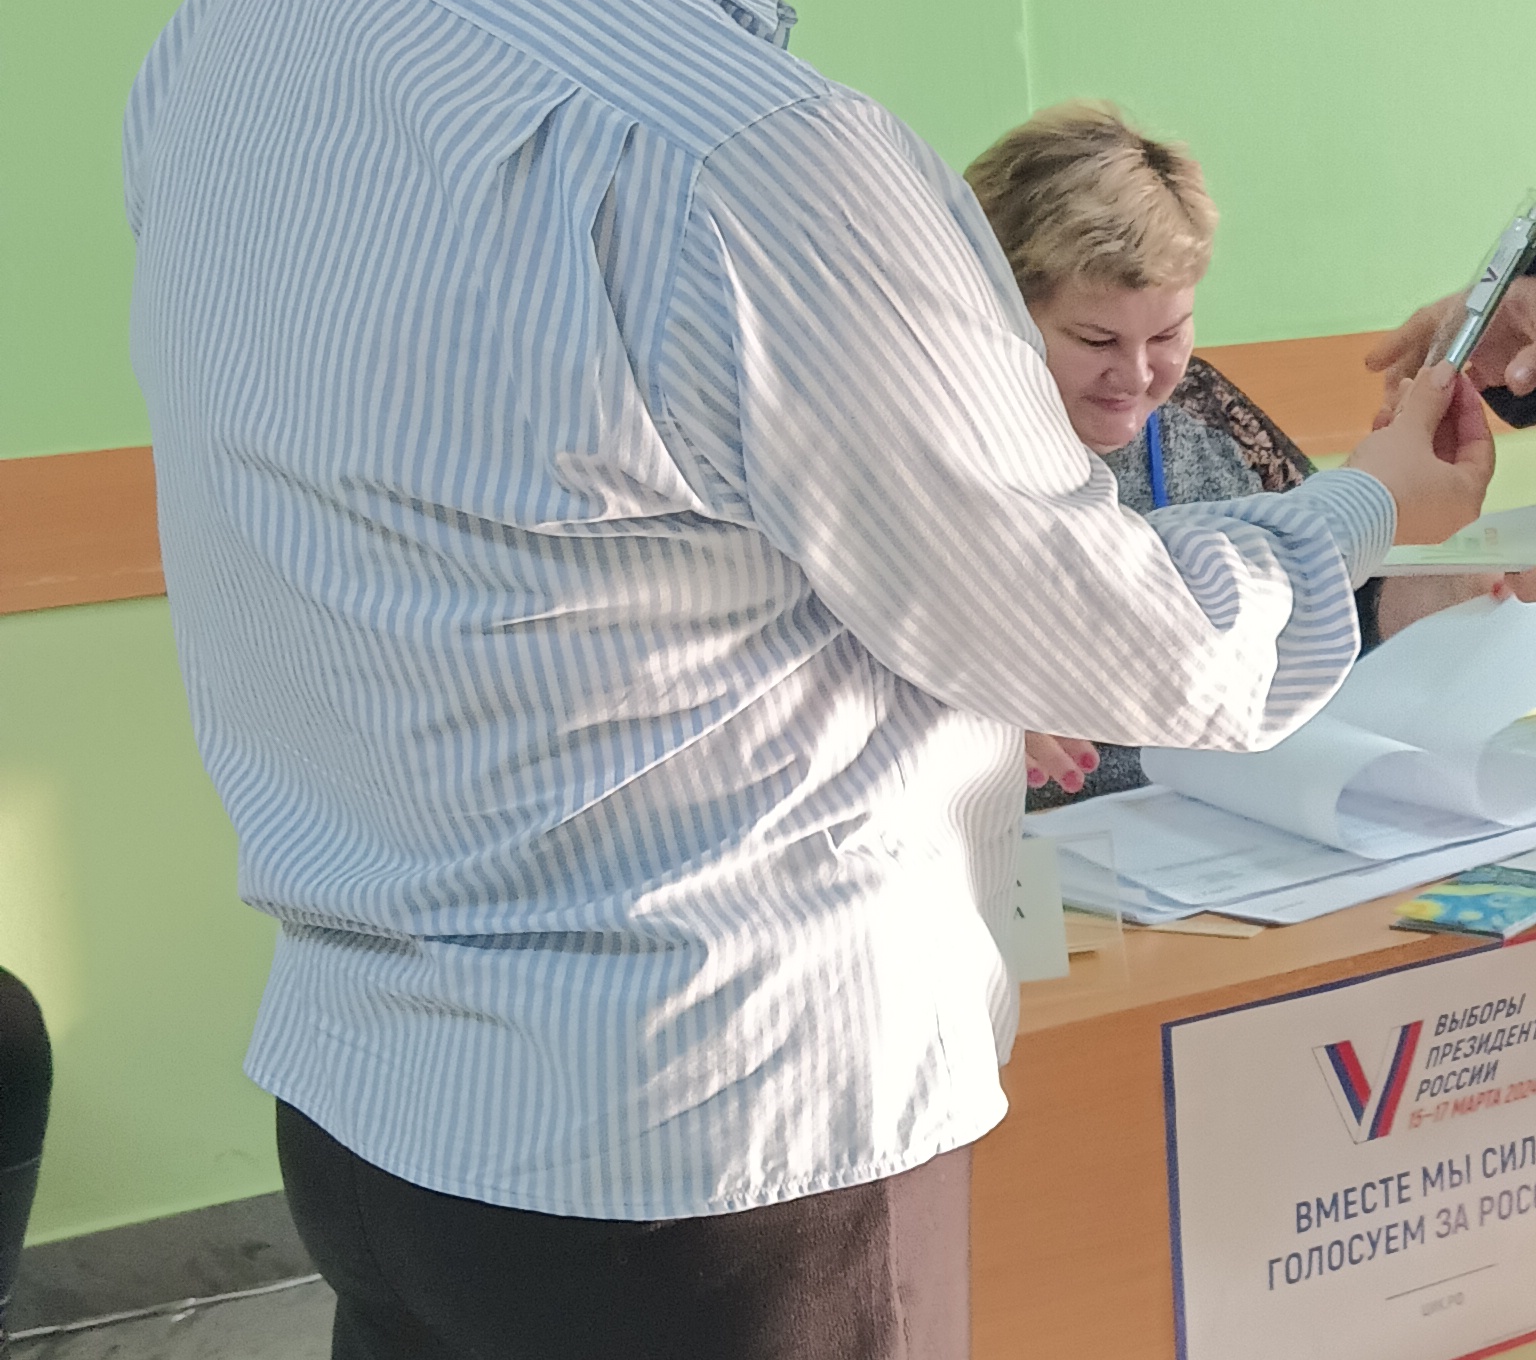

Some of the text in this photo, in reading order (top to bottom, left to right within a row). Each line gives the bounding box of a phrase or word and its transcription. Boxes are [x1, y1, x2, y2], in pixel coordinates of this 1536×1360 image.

[1434, 993, 1526, 1036] ВЫБОРЫ
[1415, 1060, 1499, 1102] РОССИИ
[1451, 1087, 1502, 1118] МАРТА
[1296, 1171, 1411, 1234] ВМЕСТЕ
[1422, 1154, 1471, 1197] МЫ
[1268, 1215, 1425, 1291] ГОЛОСУЕМ
[1436, 1203, 1469, 1239] ЗА
